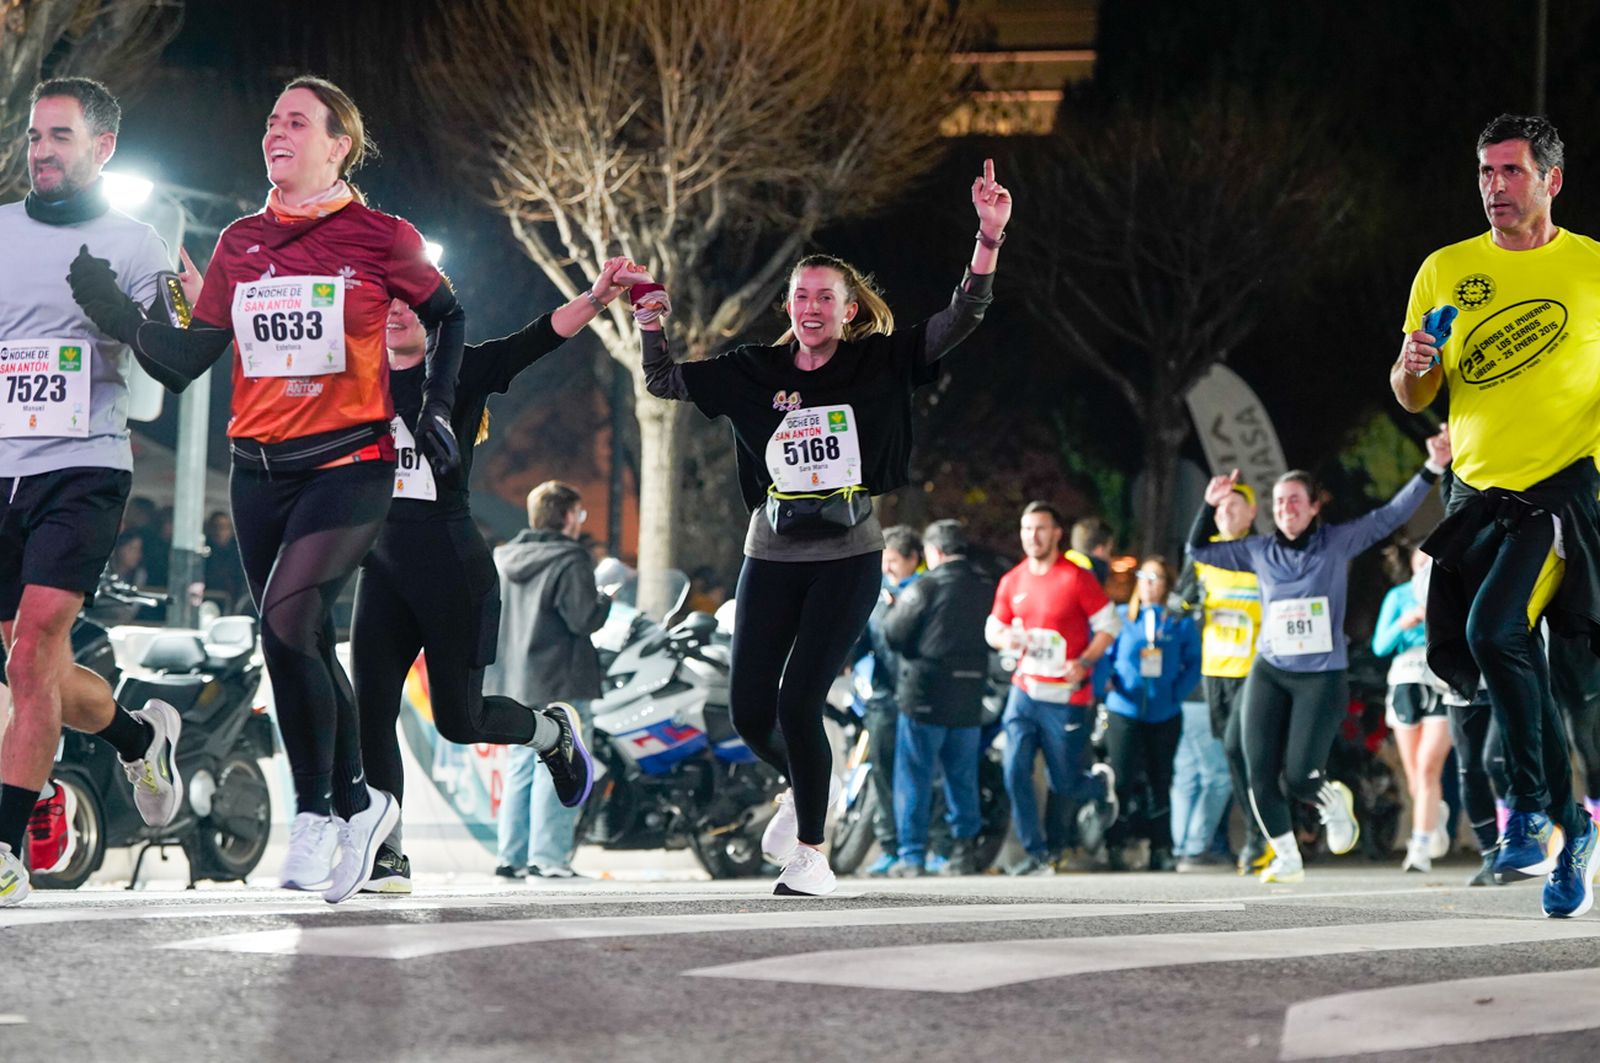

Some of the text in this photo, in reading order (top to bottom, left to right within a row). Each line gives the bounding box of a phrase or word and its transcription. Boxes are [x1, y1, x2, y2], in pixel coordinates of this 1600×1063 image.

[257, 288, 288, 298] NOCHE
[290, 287, 302, 297] DE
[244, 301, 264, 312] SAN
[253, 311, 323, 342] 6633
[1480, 330, 1505, 350] CROSS
[1504, 323, 1516, 334] DE
[1515, 302, 1552, 327] INVIERNO
[1496, 319, 1541, 351] LOS CERROS
[1502, 349, 1514, 360] 25
[1513, 333, 1539, 352] ENERO
[1538, 320, 1559, 337] 2015
[9, 351, 36, 360] NOCHE
[38, 350, 49, 360] DE
[0, 362, 16, 374] SAN
[6, 374, 67, 403] 7523
[786, 420, 807, 429] OCHE
[810, 416, 820, 425] DE
[775, 431, 790, 441] SAN
[783, 435, 840, 466] 5168
[1287, 619, 1313, 635] 891
